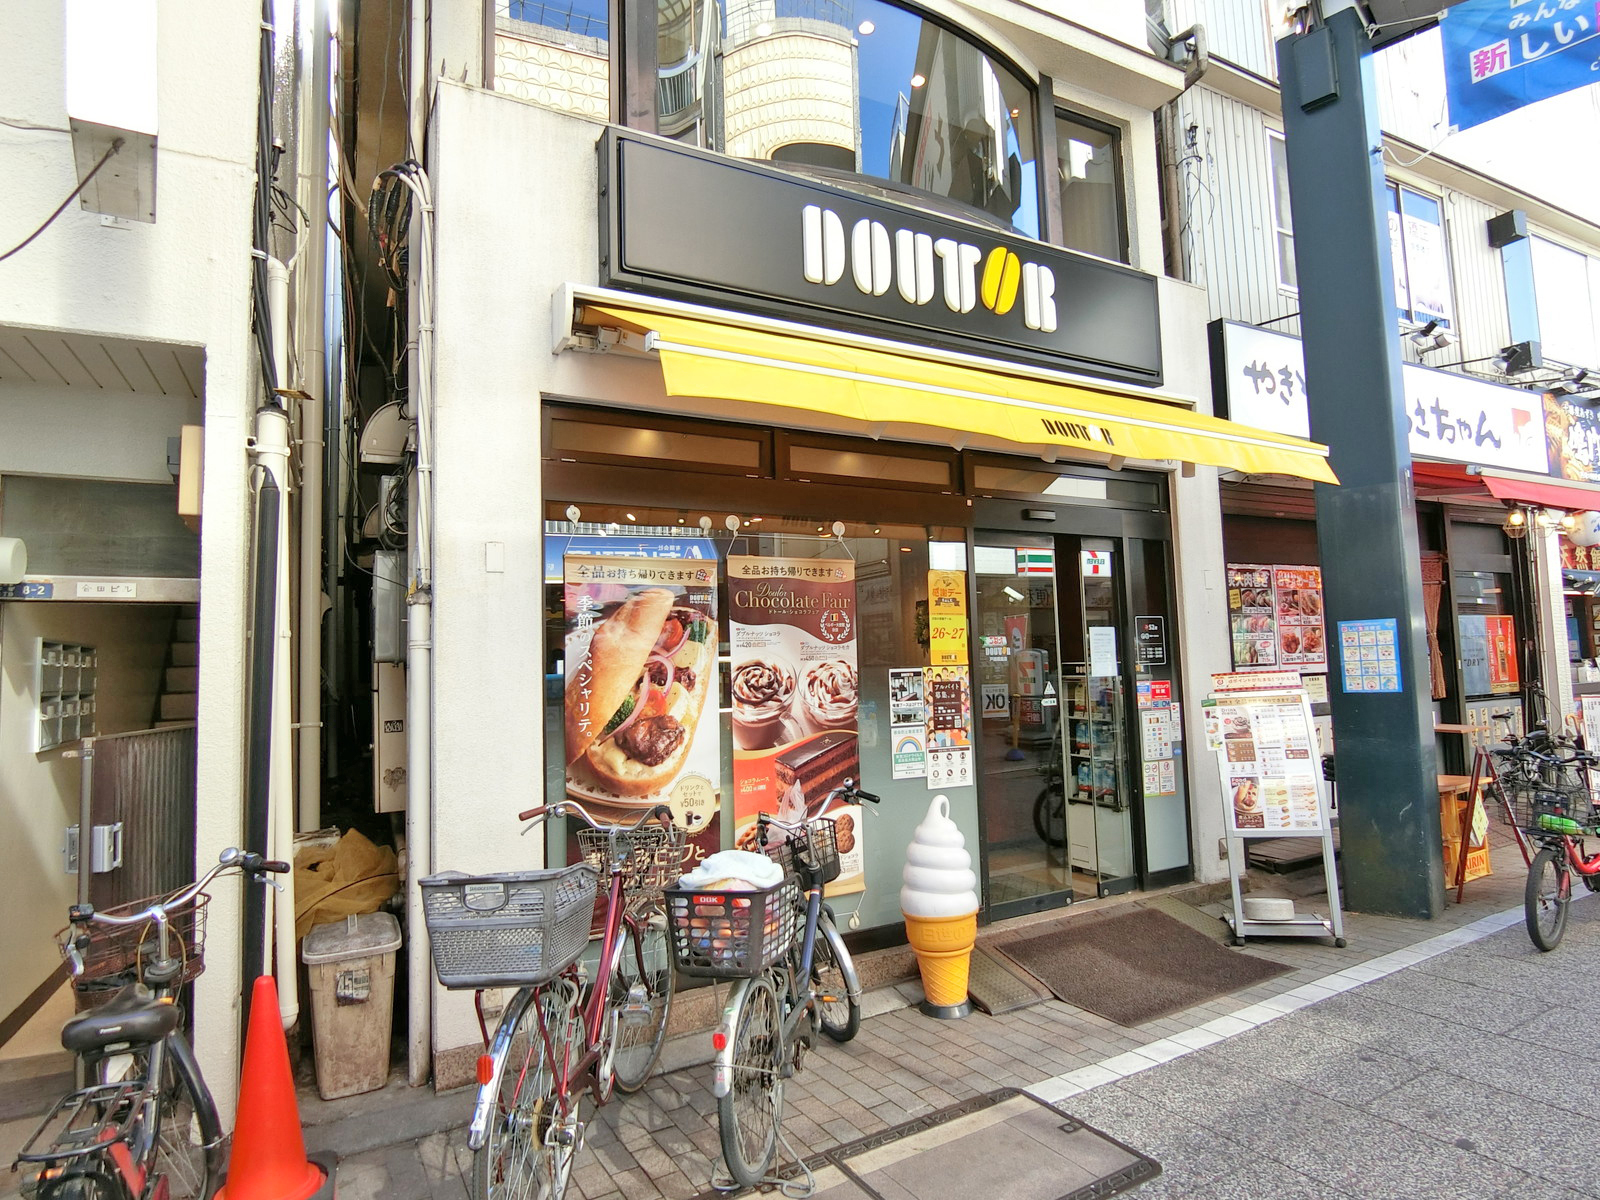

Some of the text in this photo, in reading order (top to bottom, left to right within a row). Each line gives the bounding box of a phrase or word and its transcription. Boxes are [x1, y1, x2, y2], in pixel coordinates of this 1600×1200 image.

[803, 203, 1058, 333] DOUTOR
[1041, 418, 1115, 446] DOUTOR
[577, 564, 694, 581] 全品お持ち帰りできます
[742, 565, 833, 577] 全品お持ち帰りできます
[735, 590, 819, 608] Chocolate
[822, 592, 850, 608] Fair
[576, 595, 593, 738] 季節のスペシャリテ。
